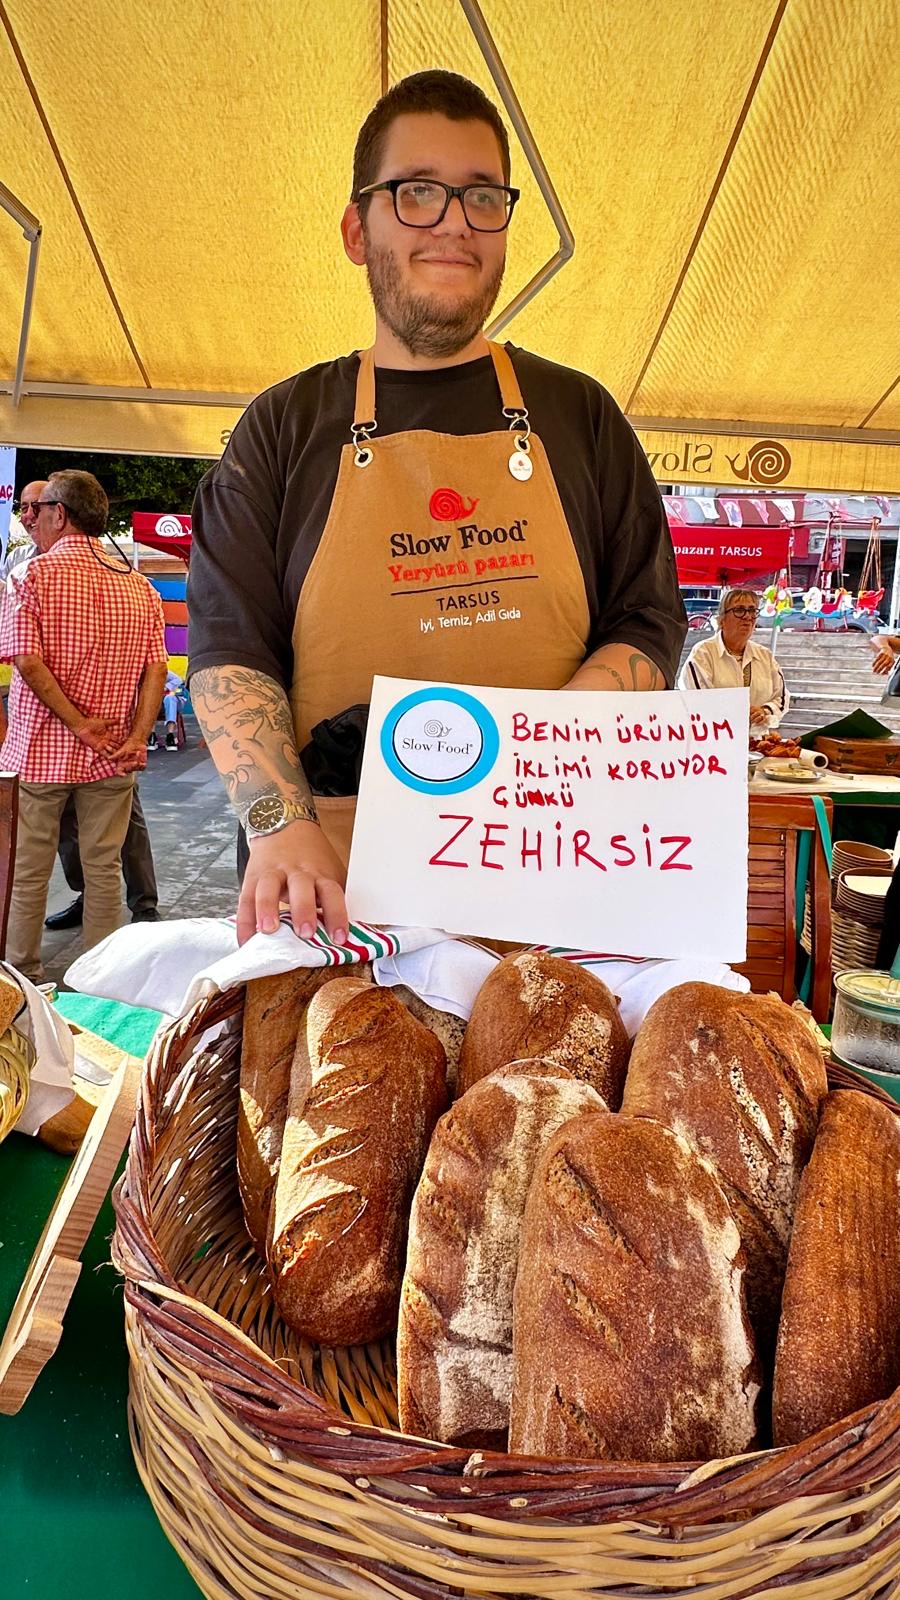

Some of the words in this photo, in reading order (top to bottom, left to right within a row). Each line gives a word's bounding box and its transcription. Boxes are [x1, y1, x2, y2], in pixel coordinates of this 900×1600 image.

[390, 533, 451, 558] Slow
[719, 546, 763, 557] TARSUS
[387, 559, 470, 582] Yeryüzü
[474, 553, 535, 574] pazarı
[436, 590, 501, 611] TARSUS
[438, 614, 473, 628] Temiz,
[475, 609, 496, 623] Adil
[511, 712, 602, 744] BENİM
[616, 713, 734, 743] ÜRÜNÜM
[402, 737, 433, 752] Slow
[513, 752, 592, 779] İKLİMİ
[607, 754, 727, 780] KORUYOR
[429, 814, 693, 872] ZEHİRSİZ
